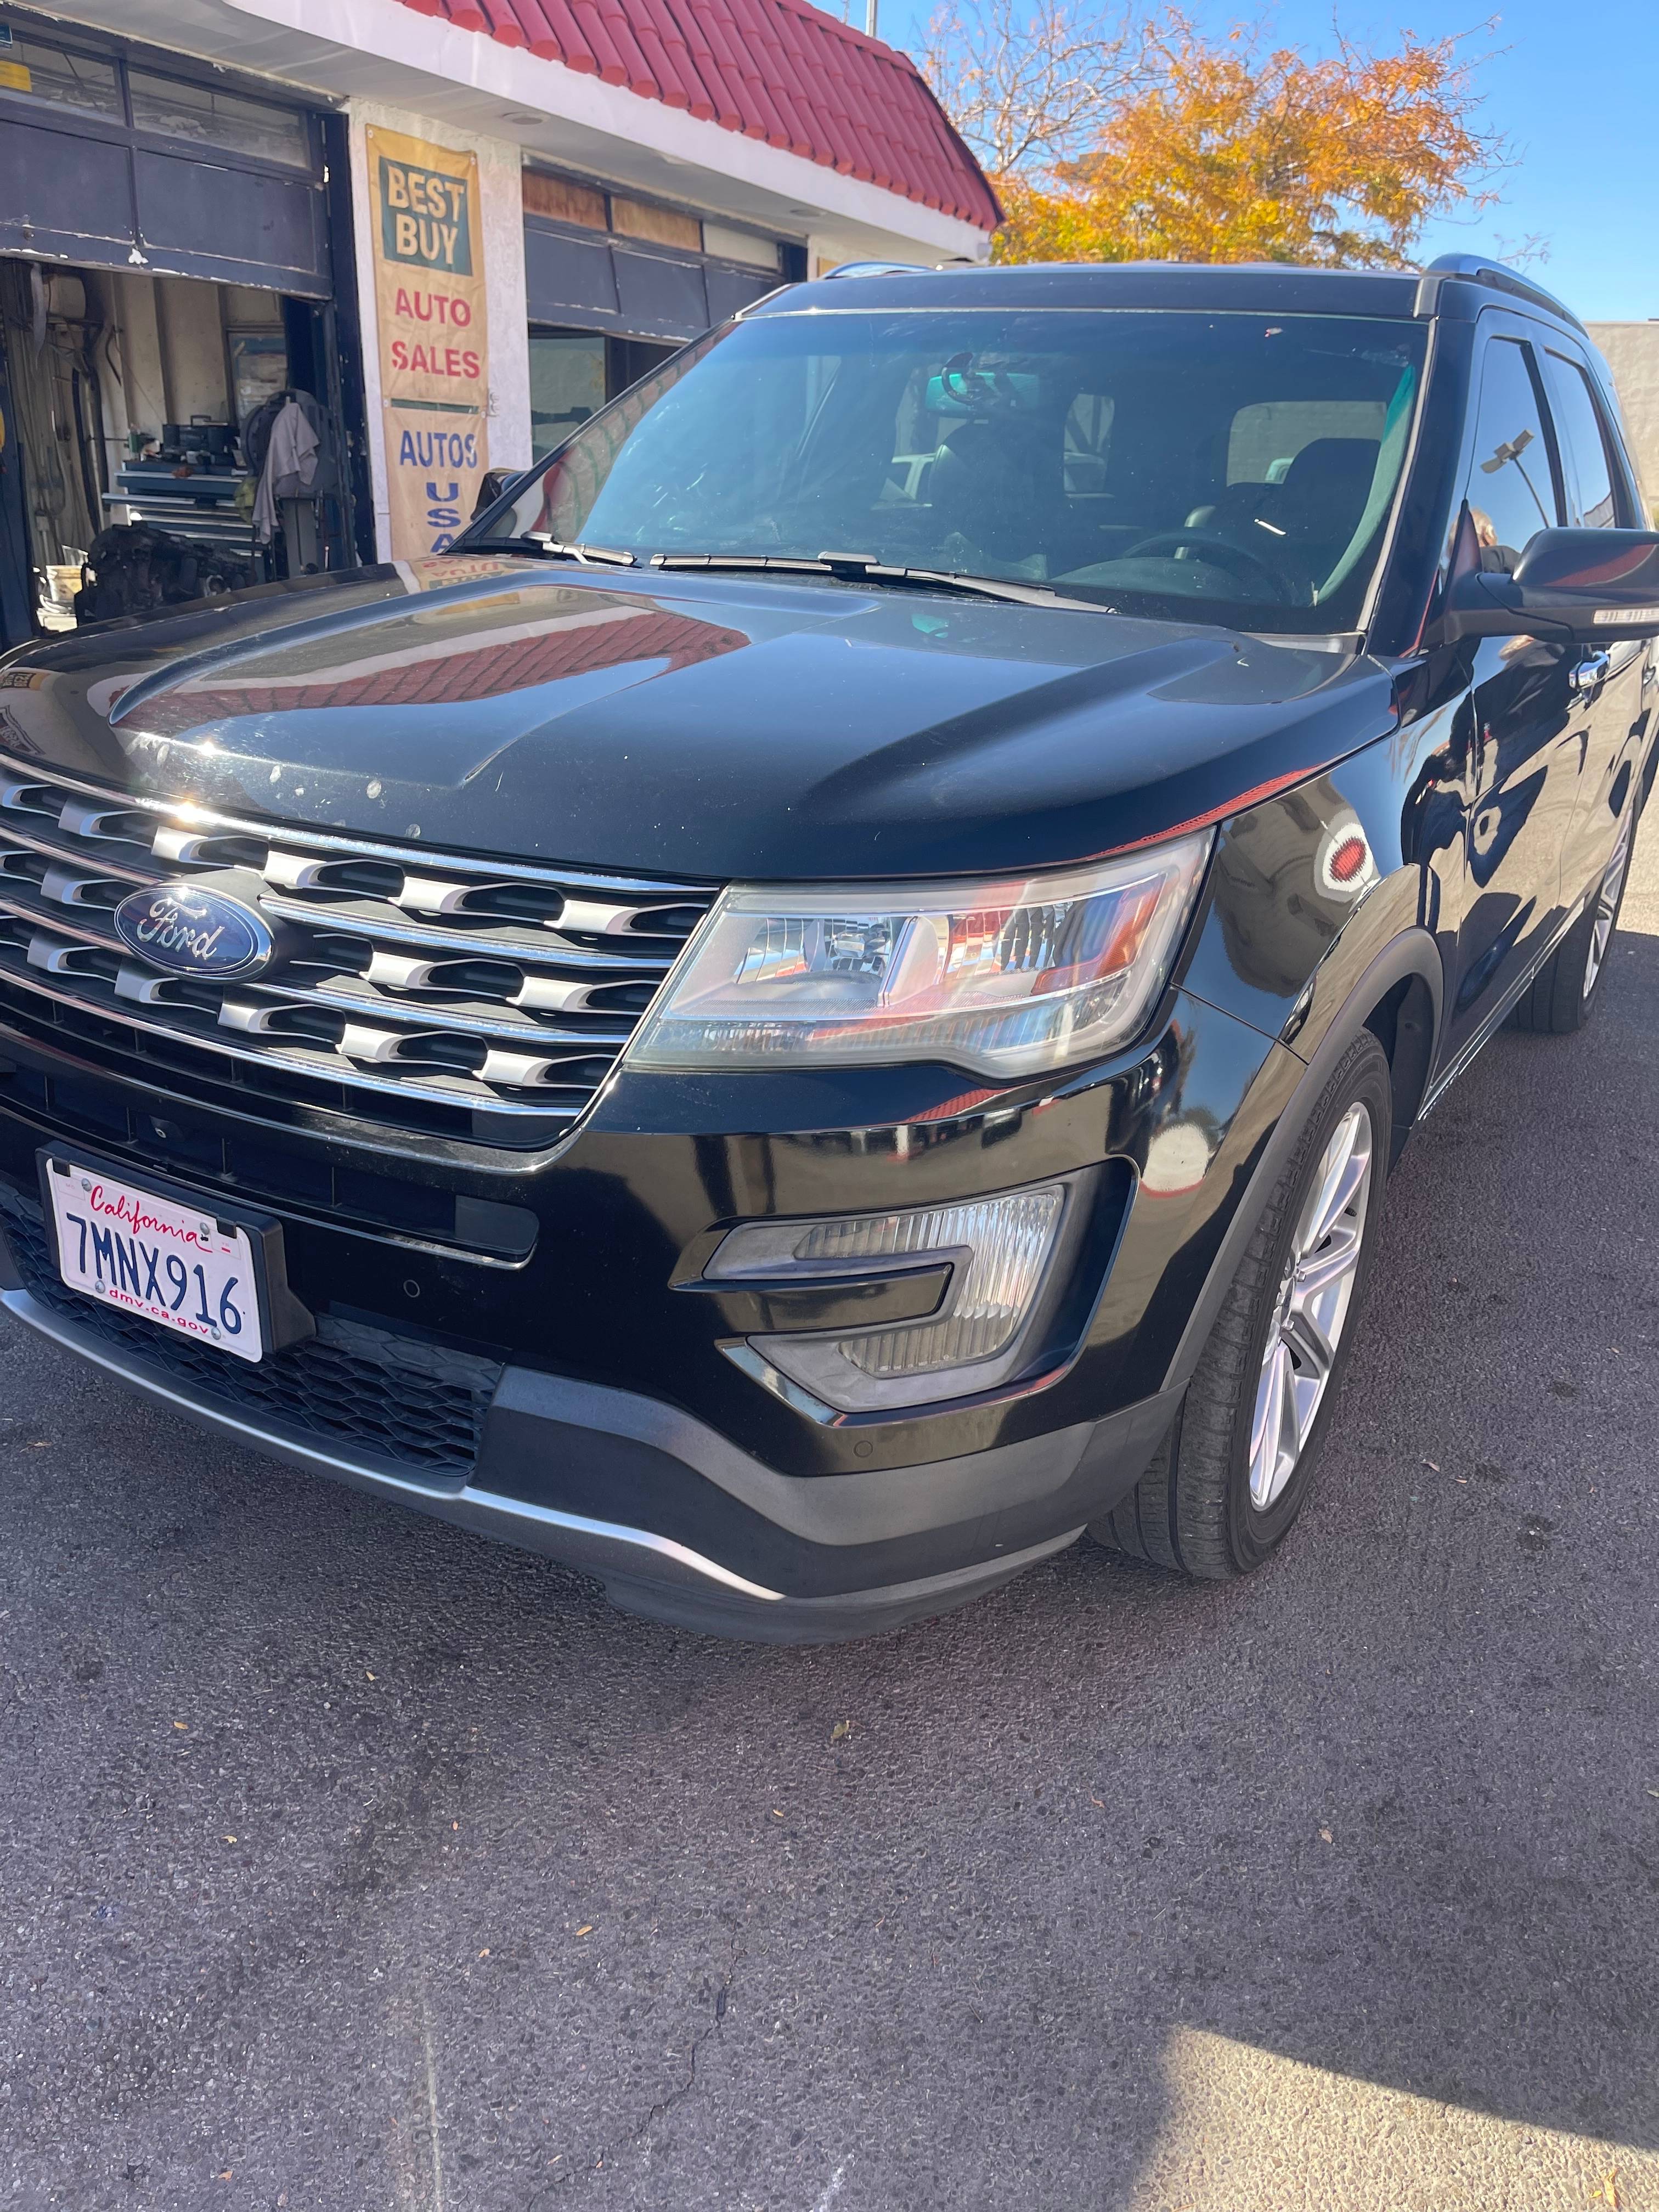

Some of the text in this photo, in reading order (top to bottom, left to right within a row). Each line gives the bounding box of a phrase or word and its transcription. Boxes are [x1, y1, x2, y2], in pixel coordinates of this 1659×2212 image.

[387, 165, 465, 222] BEST
[396, 213, 459, 264] BUY
[395, 287, 471, 327] AUTO
[391, 341, 481, 379] SALES
[400, 430, 477, 468] AUTOS
[137, 896, 225, 960] Ford
[91, 1186, 213, 1253] California
[66, 1212, 242, 1334] 7MNX916
[109, 1288, 209, 1334] dmv.ca.gov
